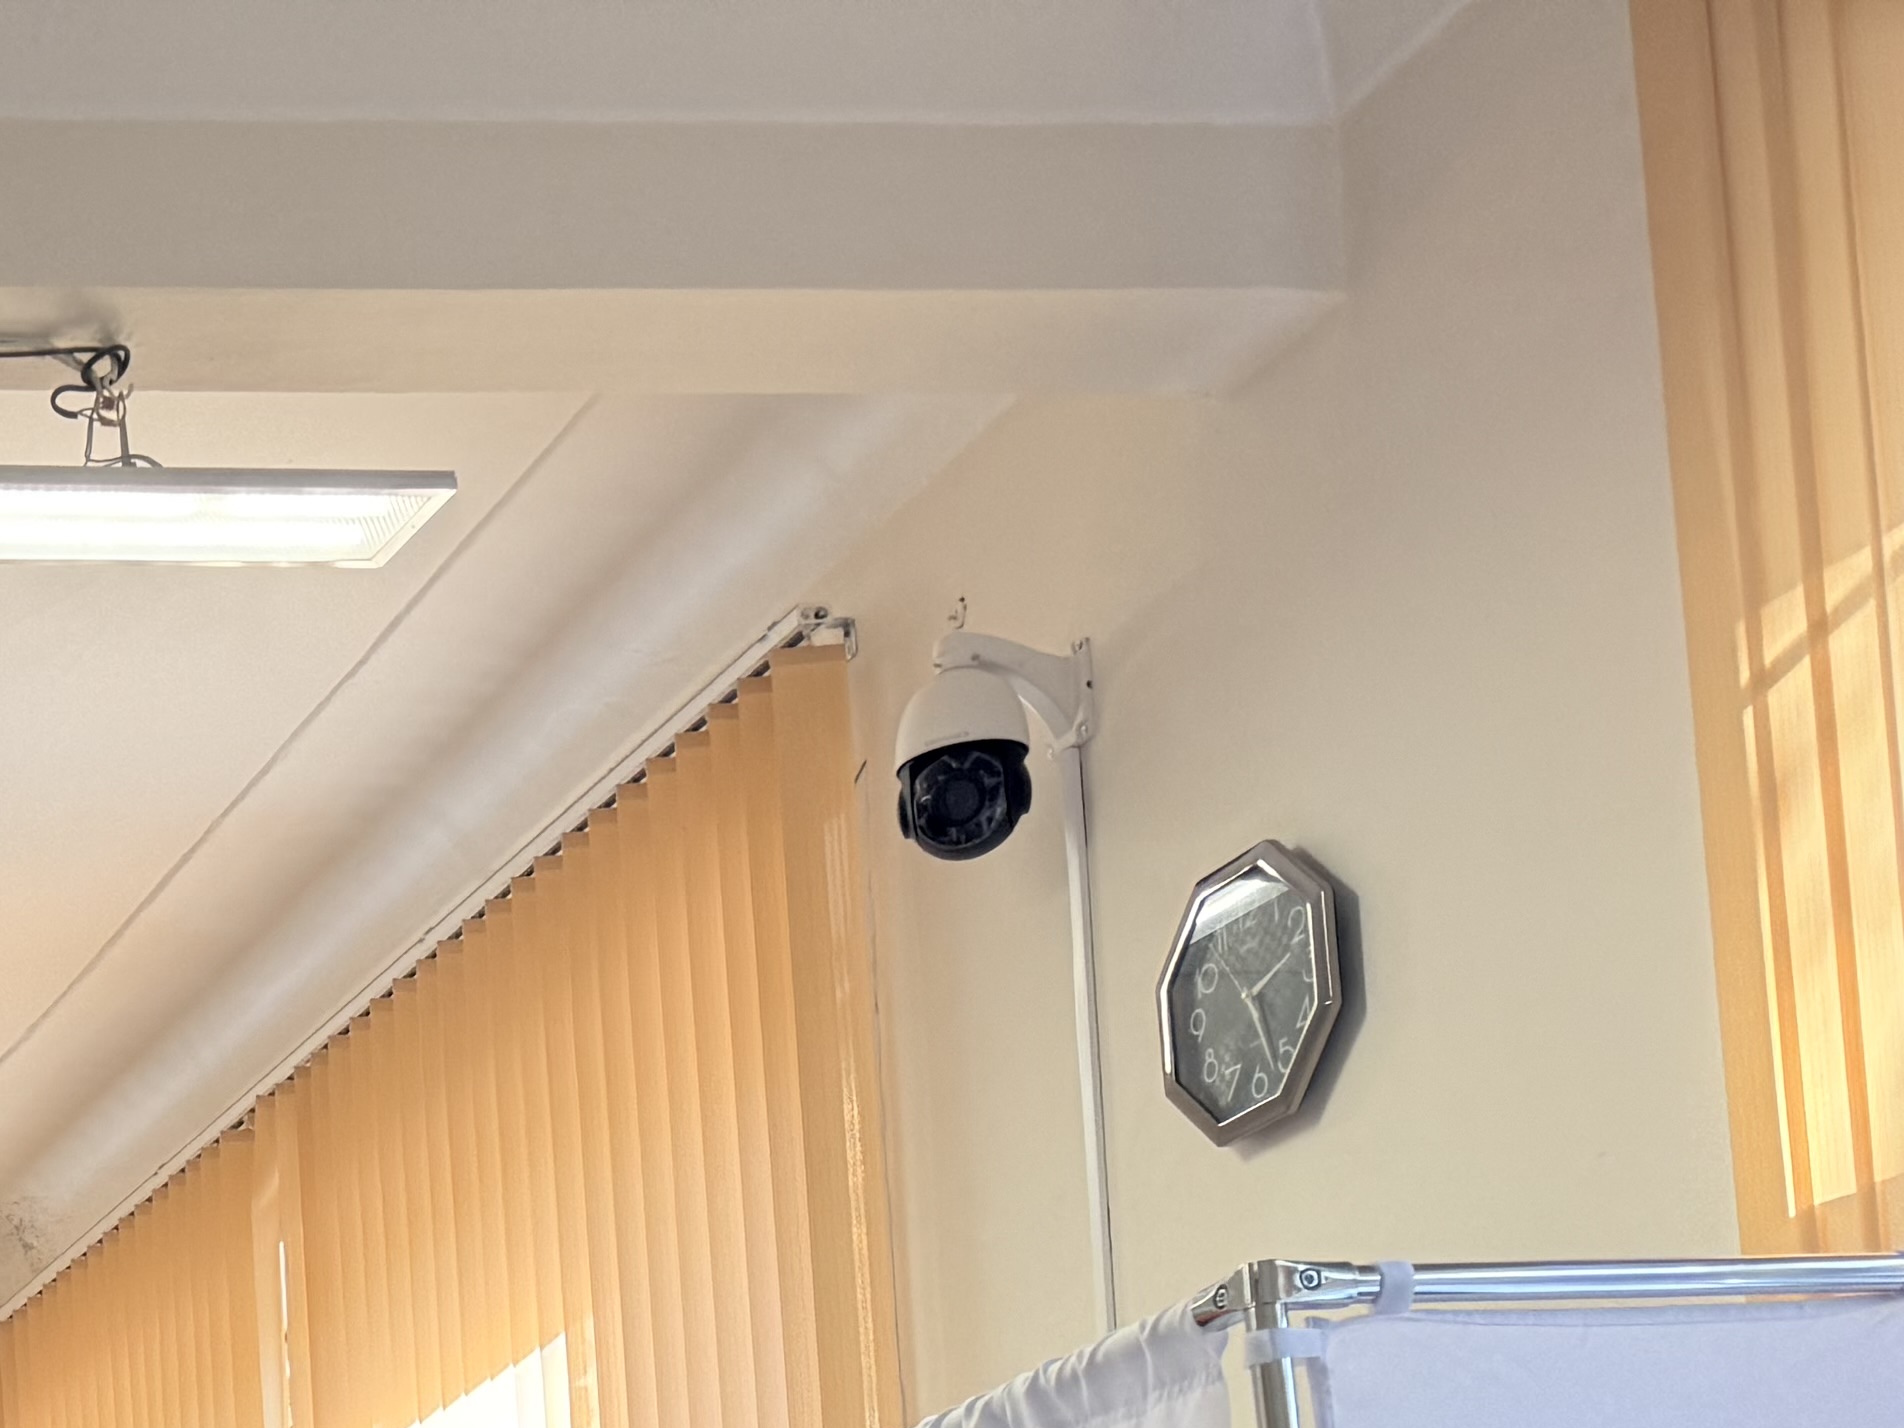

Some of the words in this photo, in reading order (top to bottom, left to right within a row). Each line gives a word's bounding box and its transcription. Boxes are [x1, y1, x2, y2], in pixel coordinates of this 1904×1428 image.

[1288, 906, 1306, 944] 2
[1195, 963, 1219, 999] 10
[1190, 1008, 1206, 1043] 9
[1203, 1048, 1218, 1083] 8
[1225, 1063, 1242, 1101] 7
[1252, 1066, 1269, 1098] 6
